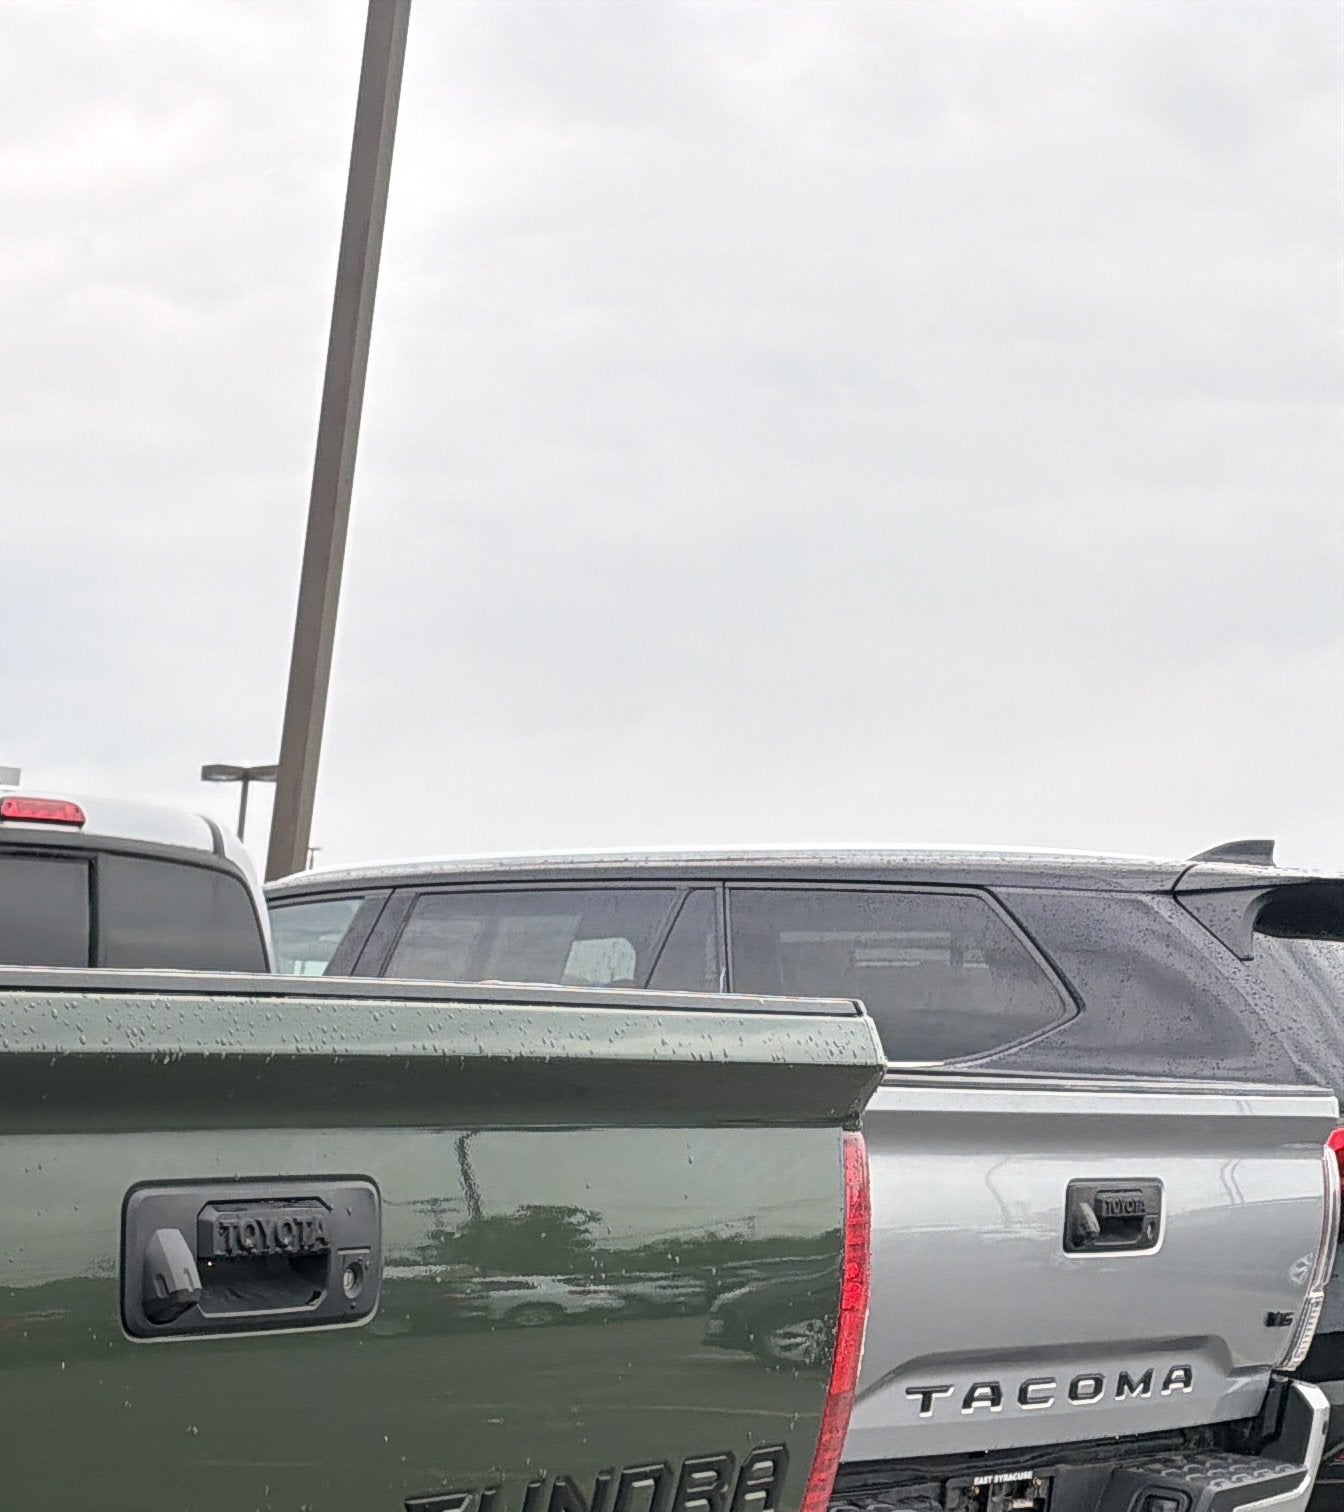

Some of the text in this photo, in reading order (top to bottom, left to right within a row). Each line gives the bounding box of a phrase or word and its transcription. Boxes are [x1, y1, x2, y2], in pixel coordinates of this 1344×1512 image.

[217, 1215, 330, 1254] TOYOTA
[904, 1363, 1194, 1419] TACOMA
[973, 1470, 1034, 1486] EAST SYRACUSE
